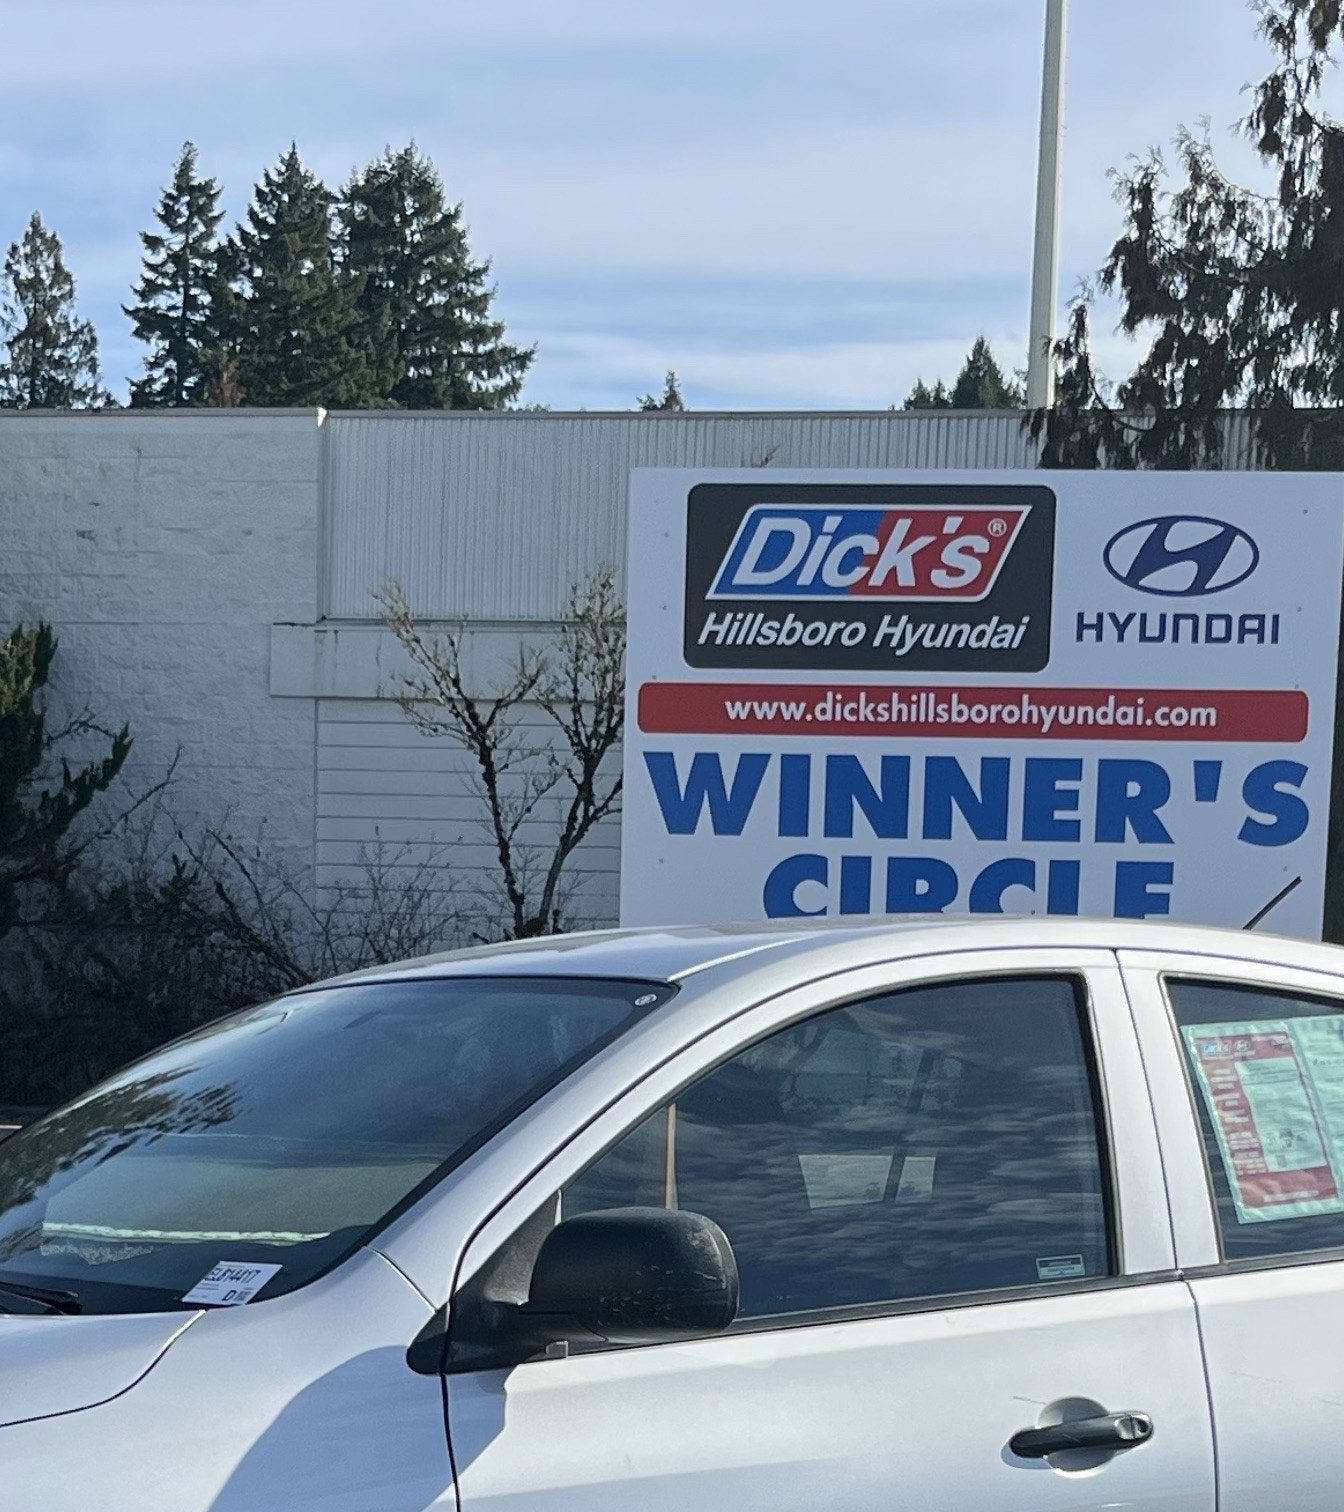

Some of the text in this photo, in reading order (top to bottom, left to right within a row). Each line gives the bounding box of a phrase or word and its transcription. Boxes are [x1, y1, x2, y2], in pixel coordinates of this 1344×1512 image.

[731, 514, 992, 588] Dick's
[697, 612, 1031, 656] Hillsboro Hyundai
[1076, 611, 1279, 645] HYUNDAI
[725, 692, 1217, 733] www.dickshillsborohyundai.com
[643, 752, 1310, 847] WINNER'S
